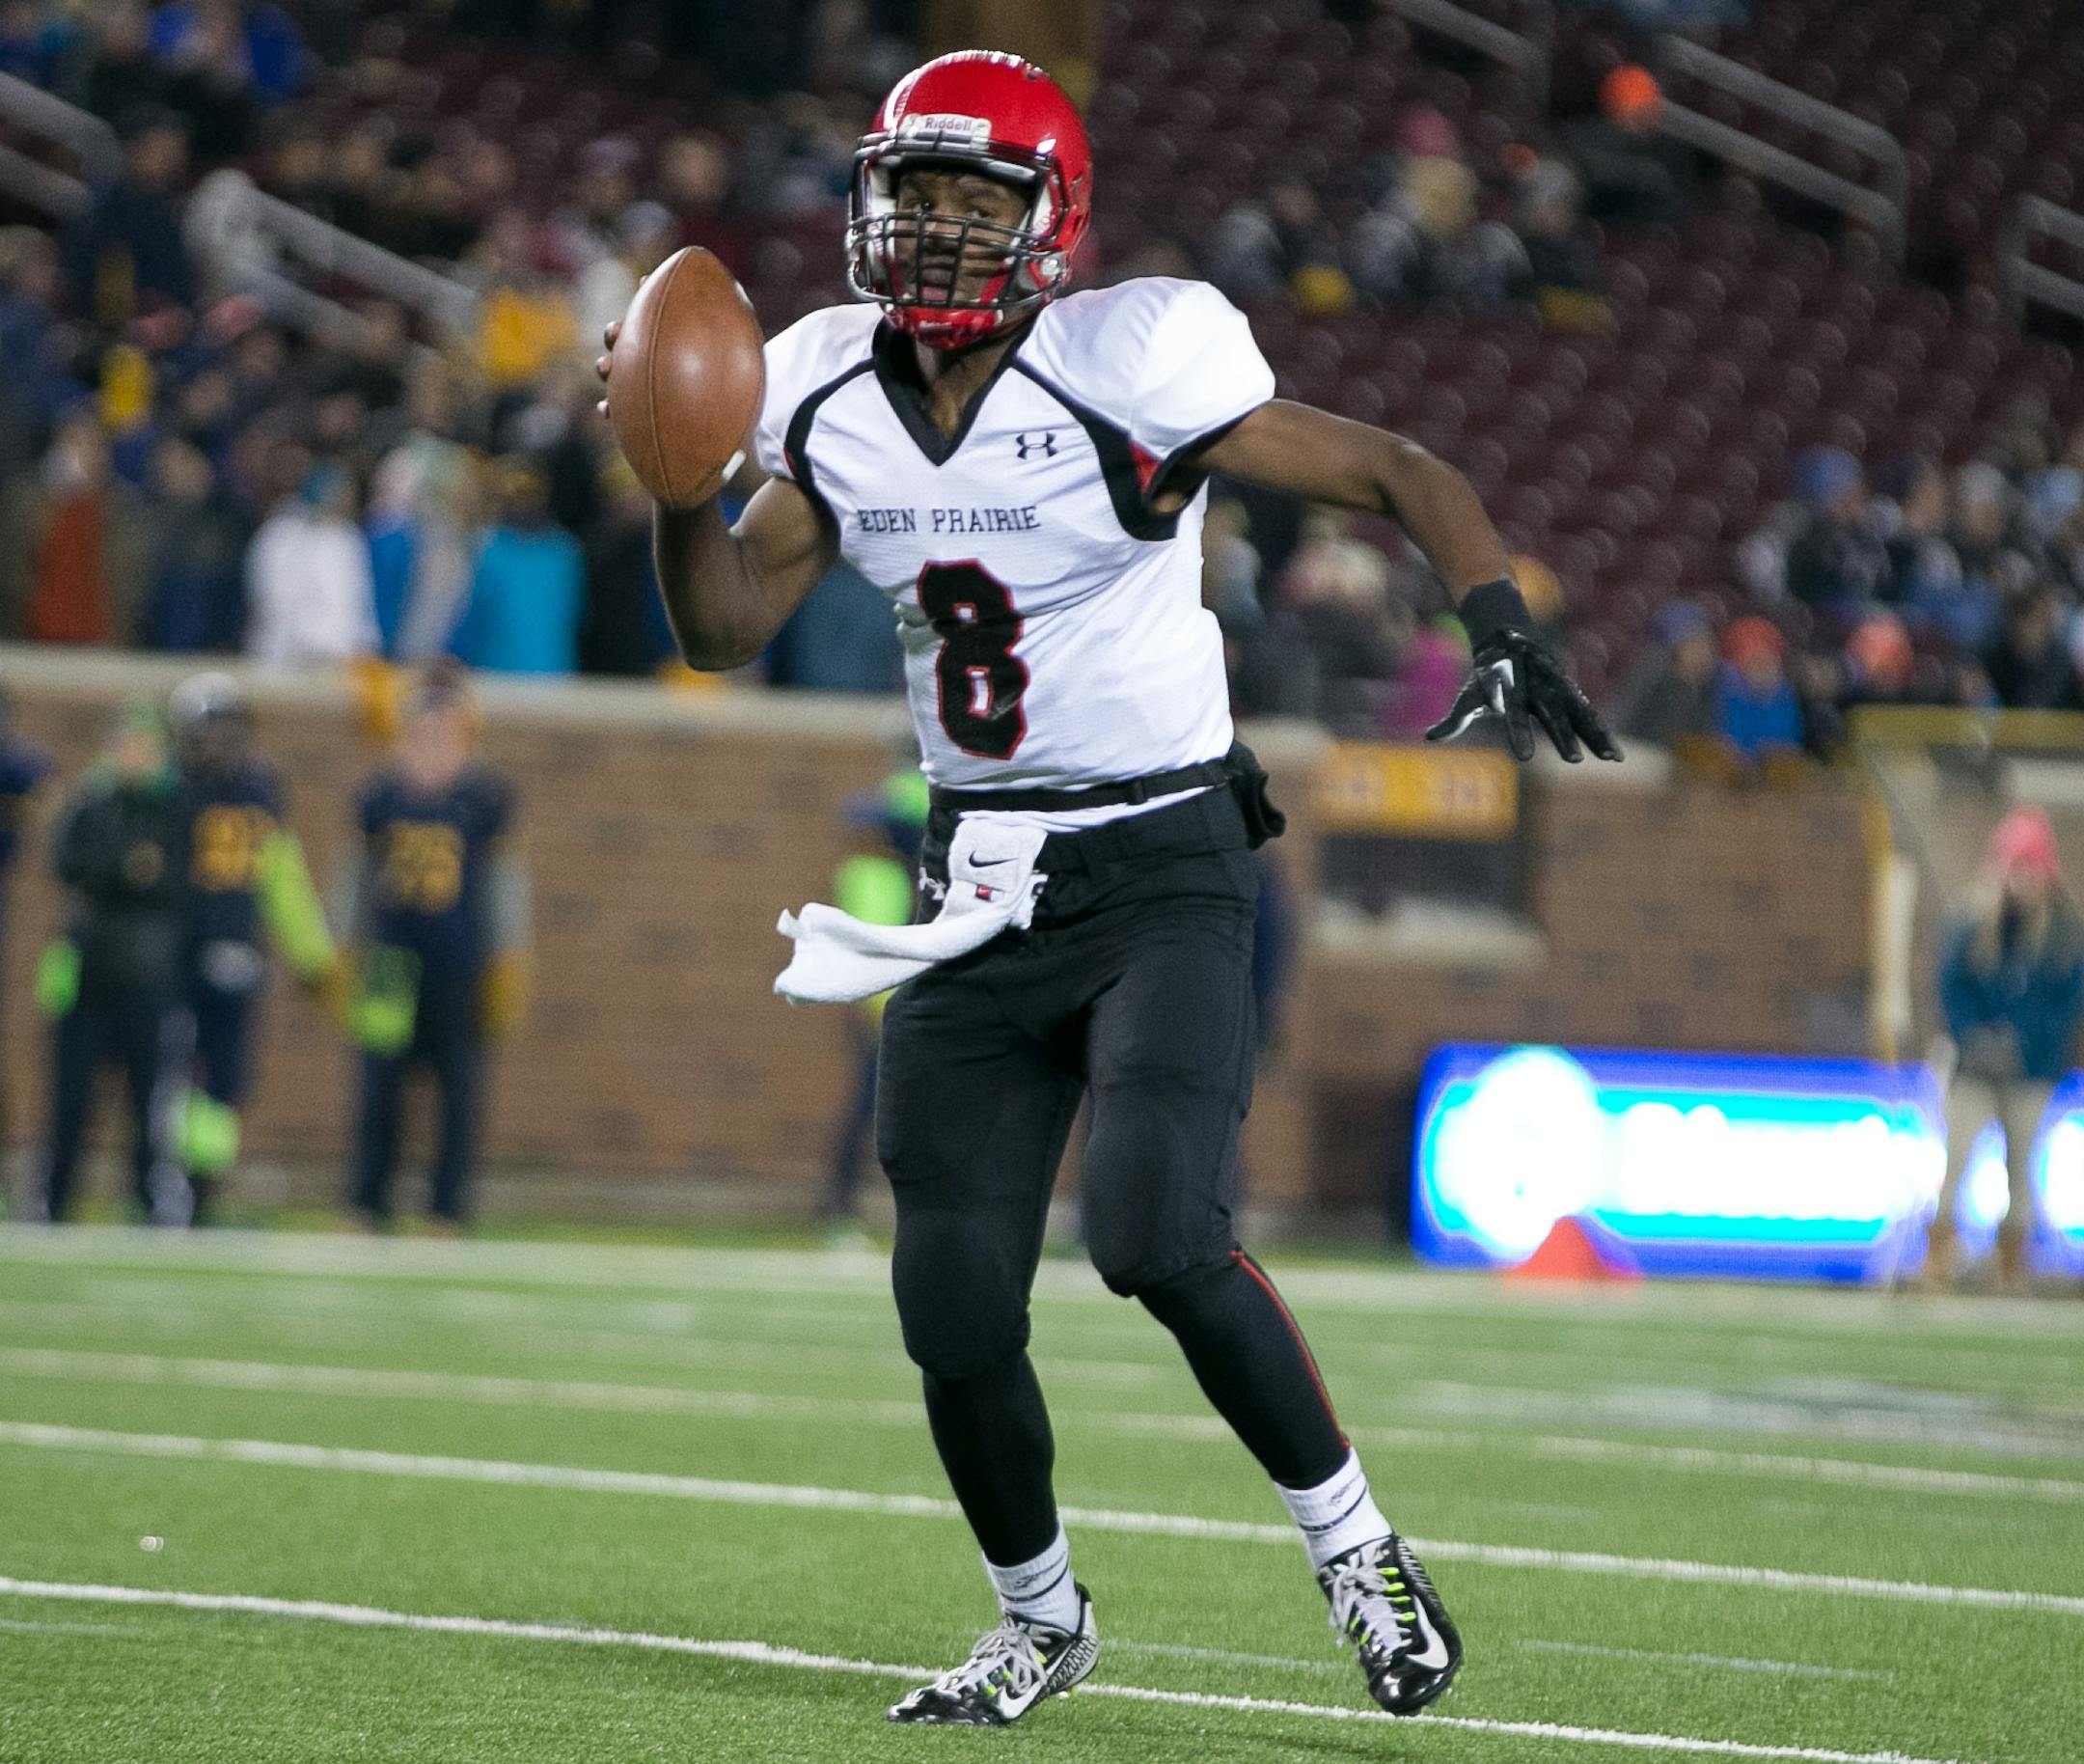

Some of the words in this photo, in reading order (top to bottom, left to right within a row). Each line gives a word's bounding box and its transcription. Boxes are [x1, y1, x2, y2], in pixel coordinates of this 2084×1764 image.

[924, 117, 973, 131] Riddell
[857, 508, 917, 533] EDEN
[931, 506, 1041, 532] PRAIRIE
[917, 558, 1030, 760] 8
